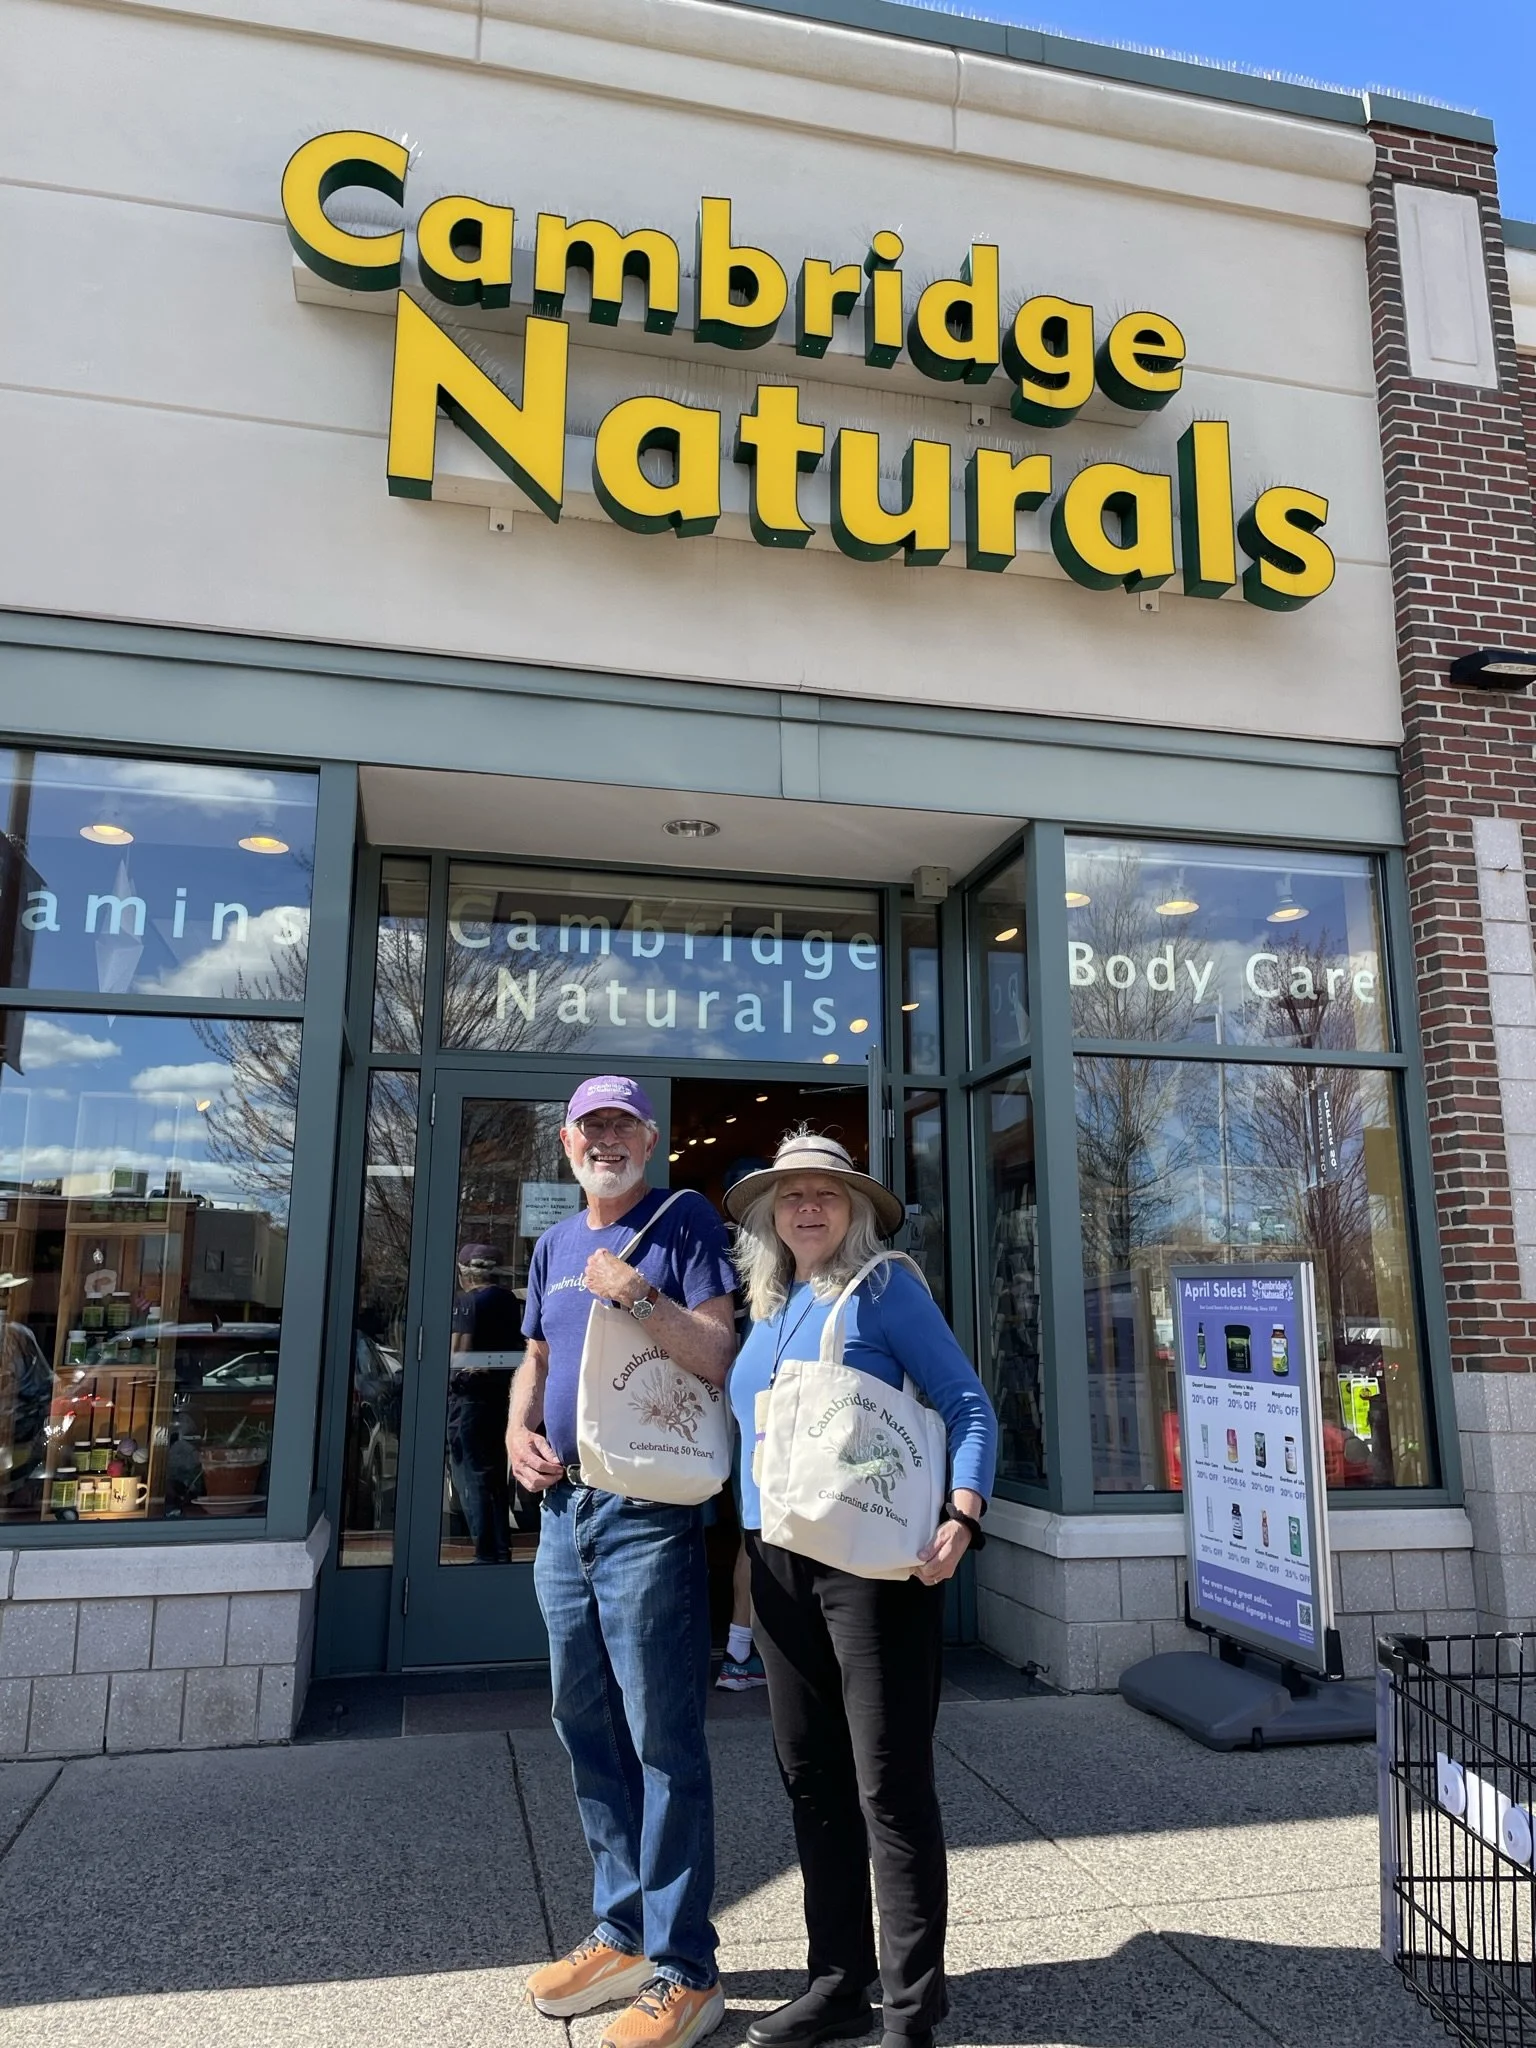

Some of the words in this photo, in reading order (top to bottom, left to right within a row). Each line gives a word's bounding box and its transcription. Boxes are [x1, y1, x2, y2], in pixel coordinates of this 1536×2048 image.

[281, 130, 1186, 426] Cambridge
[387, 289, 1336, 610] Naturals
[0, 887, 302, 945] amins
[449, 892, 877, 980] Cambridge
[1068, 941, 1214, 1004] Body
[1246, 952, 1377, 1003] Care
[496, 967, 838, 1036] Naturals
[547, 1272, 587, 1296] ambridg
[1184, 1281, 1210, 1301] April
[1213, 1281, 1246, 1298] Sales!
[612, 1345, 671, 1392] Cambridg
[1191, 1394, 1206, 1405] 20%
[1206, 1396, 1219, 1406] OFF
[1227, 1398, 1243, 1410] 20%
[1243, 1400, 1257, 1411] OFF
[1266, 1402, 1284, 1415] 20%
[1285, 1405, 1300, 1417] OFF
[807, 1392, 878, 1439] Cambridge
[879, 1407, 922, 1468] Naturals
[629, 1441, 680, 1455] Celebrating
[680, 1446, 691, 1456] 50
[691, 1447, 715, 1460] Years!
[1208, 1472, 1219, 1481] OFF
[1264, 1484, 1275, 1494] OFF
[1279, 1487, 1294, 1499] 20%
[1294, 1491, 1307, 1501] OFF
[818, 1489, 870, 1513] Celebrating
[869, 1502, 884, 1515] 50
[884, 1505, 908, 1528] Years!
[1269, 1564, 1280, 1574] OFF
[1299, 1573, 1311, 1585] OFF
[1223, 1585, 1238, 1596] more
[1238, 1590, 1252, 1601] great
